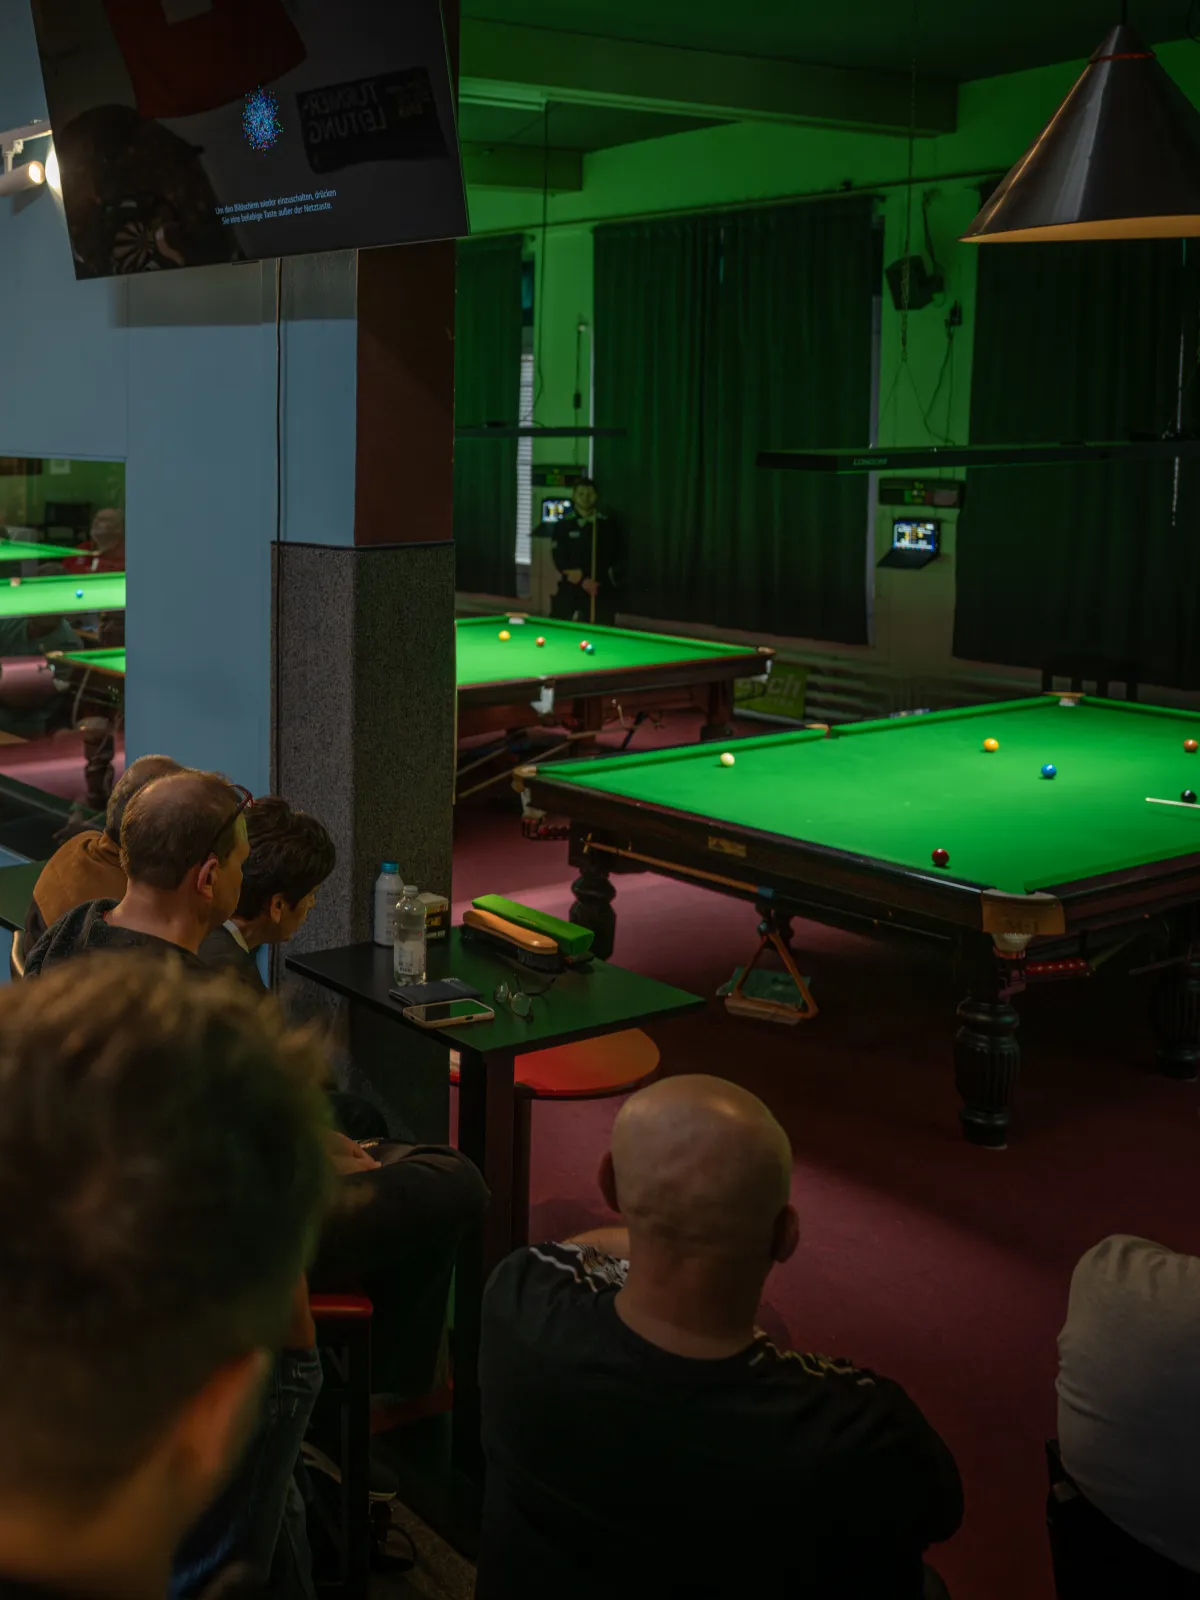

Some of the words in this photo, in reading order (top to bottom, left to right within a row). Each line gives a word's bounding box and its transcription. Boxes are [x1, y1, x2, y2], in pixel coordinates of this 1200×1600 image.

[225, 204, 234, 213] den
[260, 198, 277, 208] wieder
[314, 189, 337, 200] drücken
[264, 209, 277, 219] Taste
[293, 206, 303, 214] der
[304, 202, 333, 213] Netztaste.
